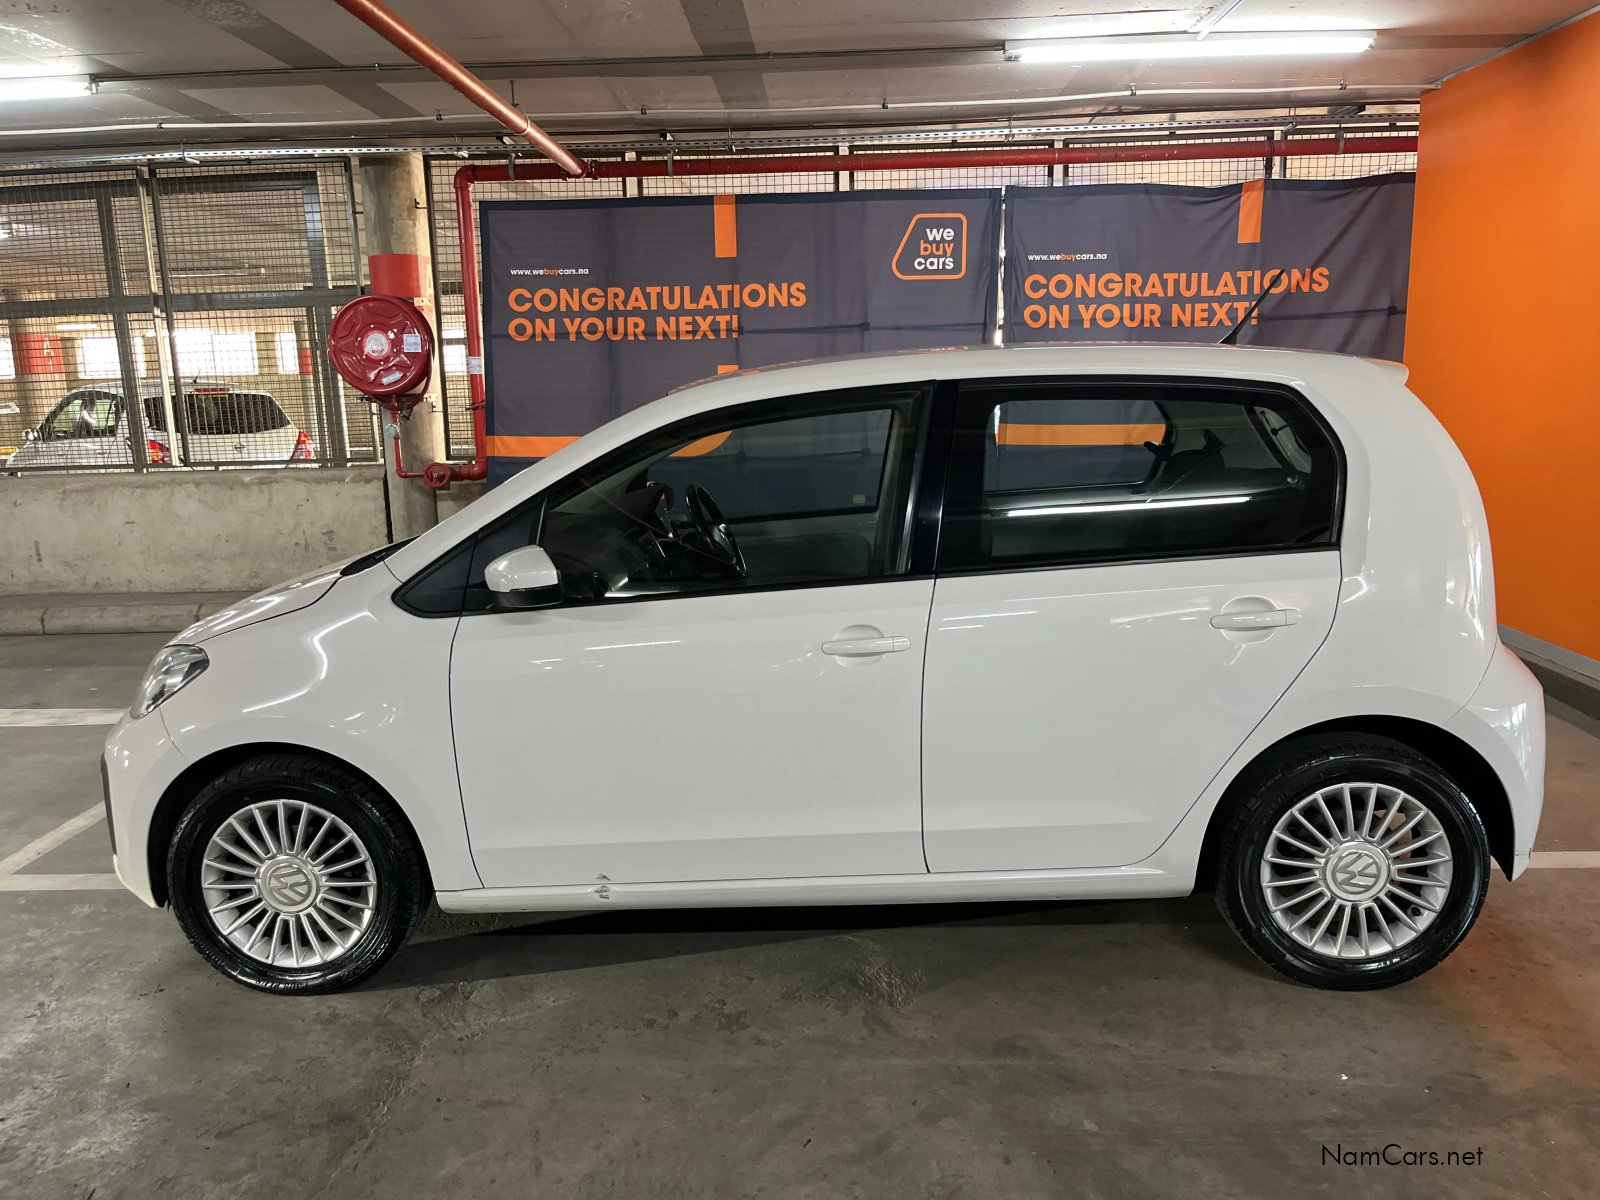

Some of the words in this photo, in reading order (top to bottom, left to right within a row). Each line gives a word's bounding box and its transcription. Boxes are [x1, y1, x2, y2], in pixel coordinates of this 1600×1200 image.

[926, 228, 955, 240] we
[920, 240, 954, 257] buy
[914, 257, 954, 270] cars
[1028, 253, 1108, 262] www.webuycars.na
[510, 267, 589, 277] www.webuycars.na
[1024, 266, 1330, 299] CONGRATULATIONS
[508, 281, 807, 312] CONGRATULATIONS
[1023, 304, 1070, 329] ON
[1077, 303, 1162, 329] YOUR
[1171, 301, 1259, 328] NEXT!
[508, 317, 556, 342] ON
[563, 316, 646, 342] YOUR
[656, 314, 739, 341] NEXT!
